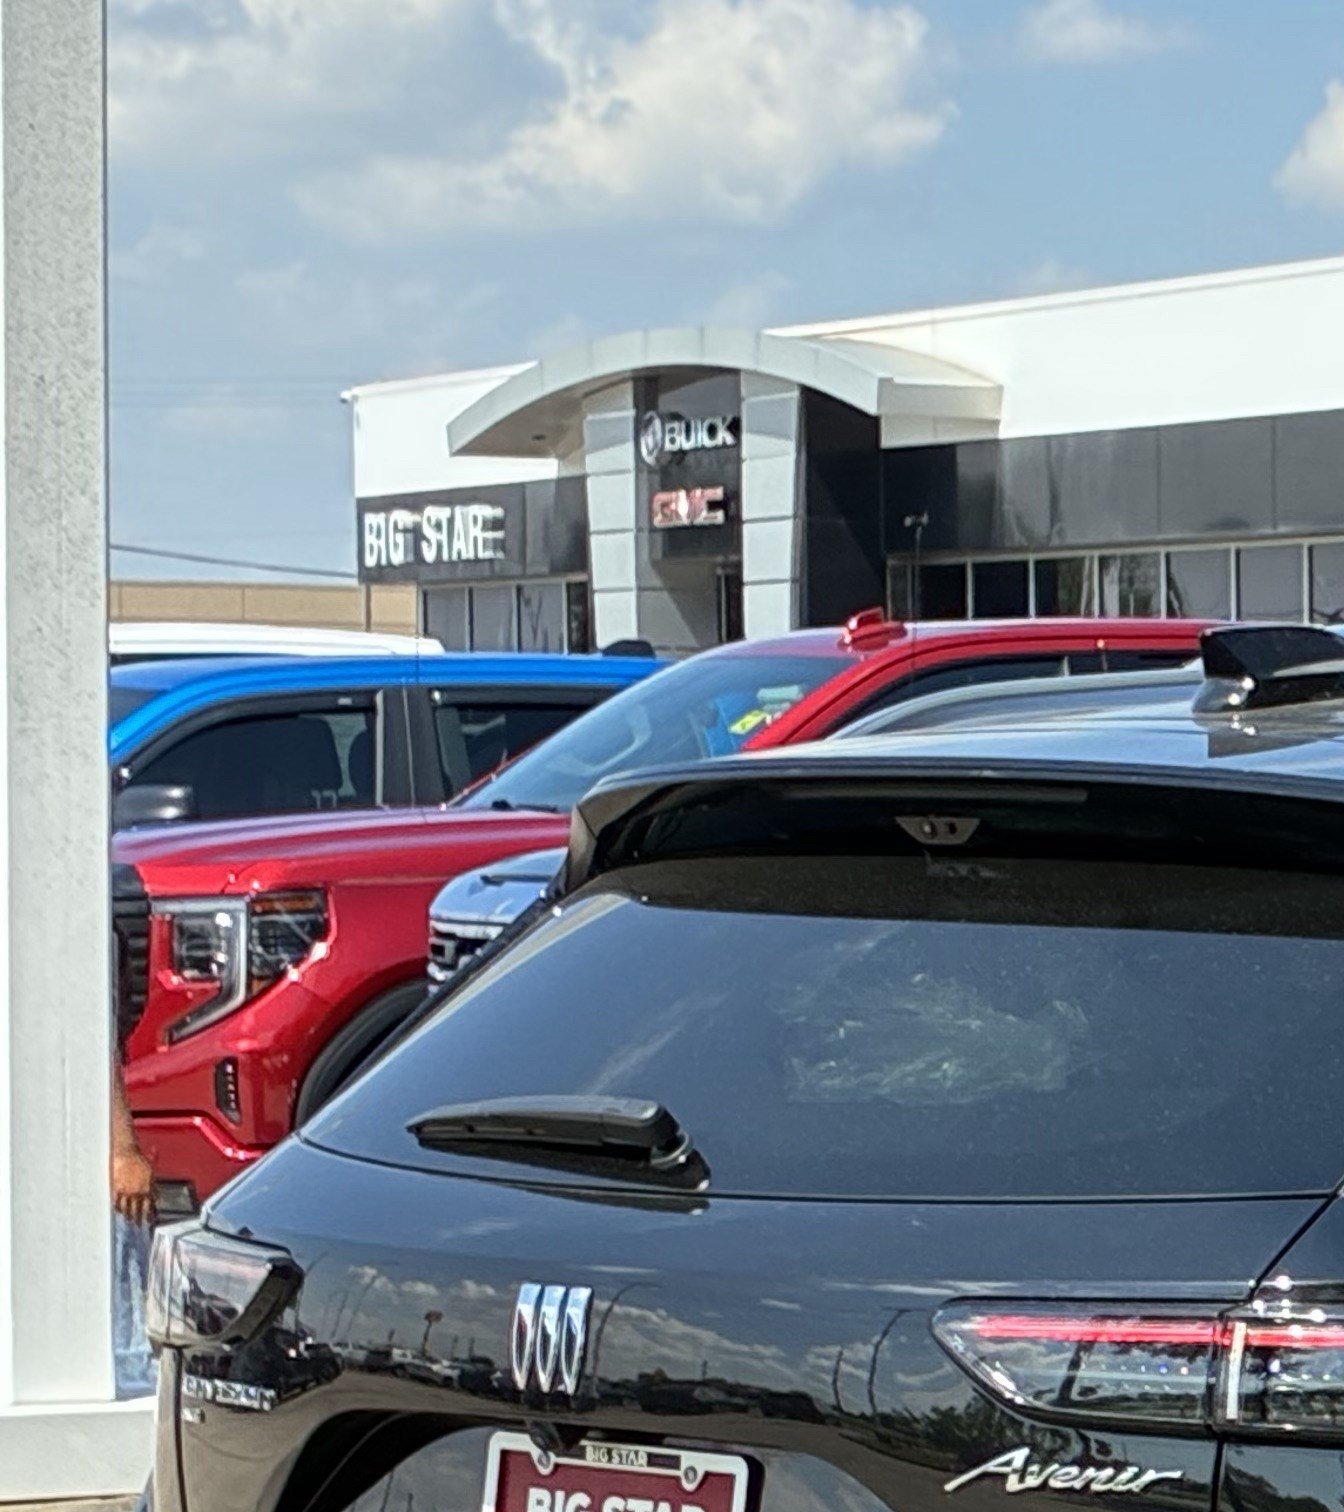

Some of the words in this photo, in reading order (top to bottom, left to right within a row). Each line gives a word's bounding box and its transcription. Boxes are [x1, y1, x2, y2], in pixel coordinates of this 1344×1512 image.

[663, 417, 737, 452] BUICK
[652, 486, 725, 529] GMC
[364, 509, 410, 568] BIG
[421, 504, 503, 564] STAR
[585, 1445, 609, 1464] BIG
[611, 1447, 648, 1468] STAR
[943, 1446, 1184, 1493] Avenir
